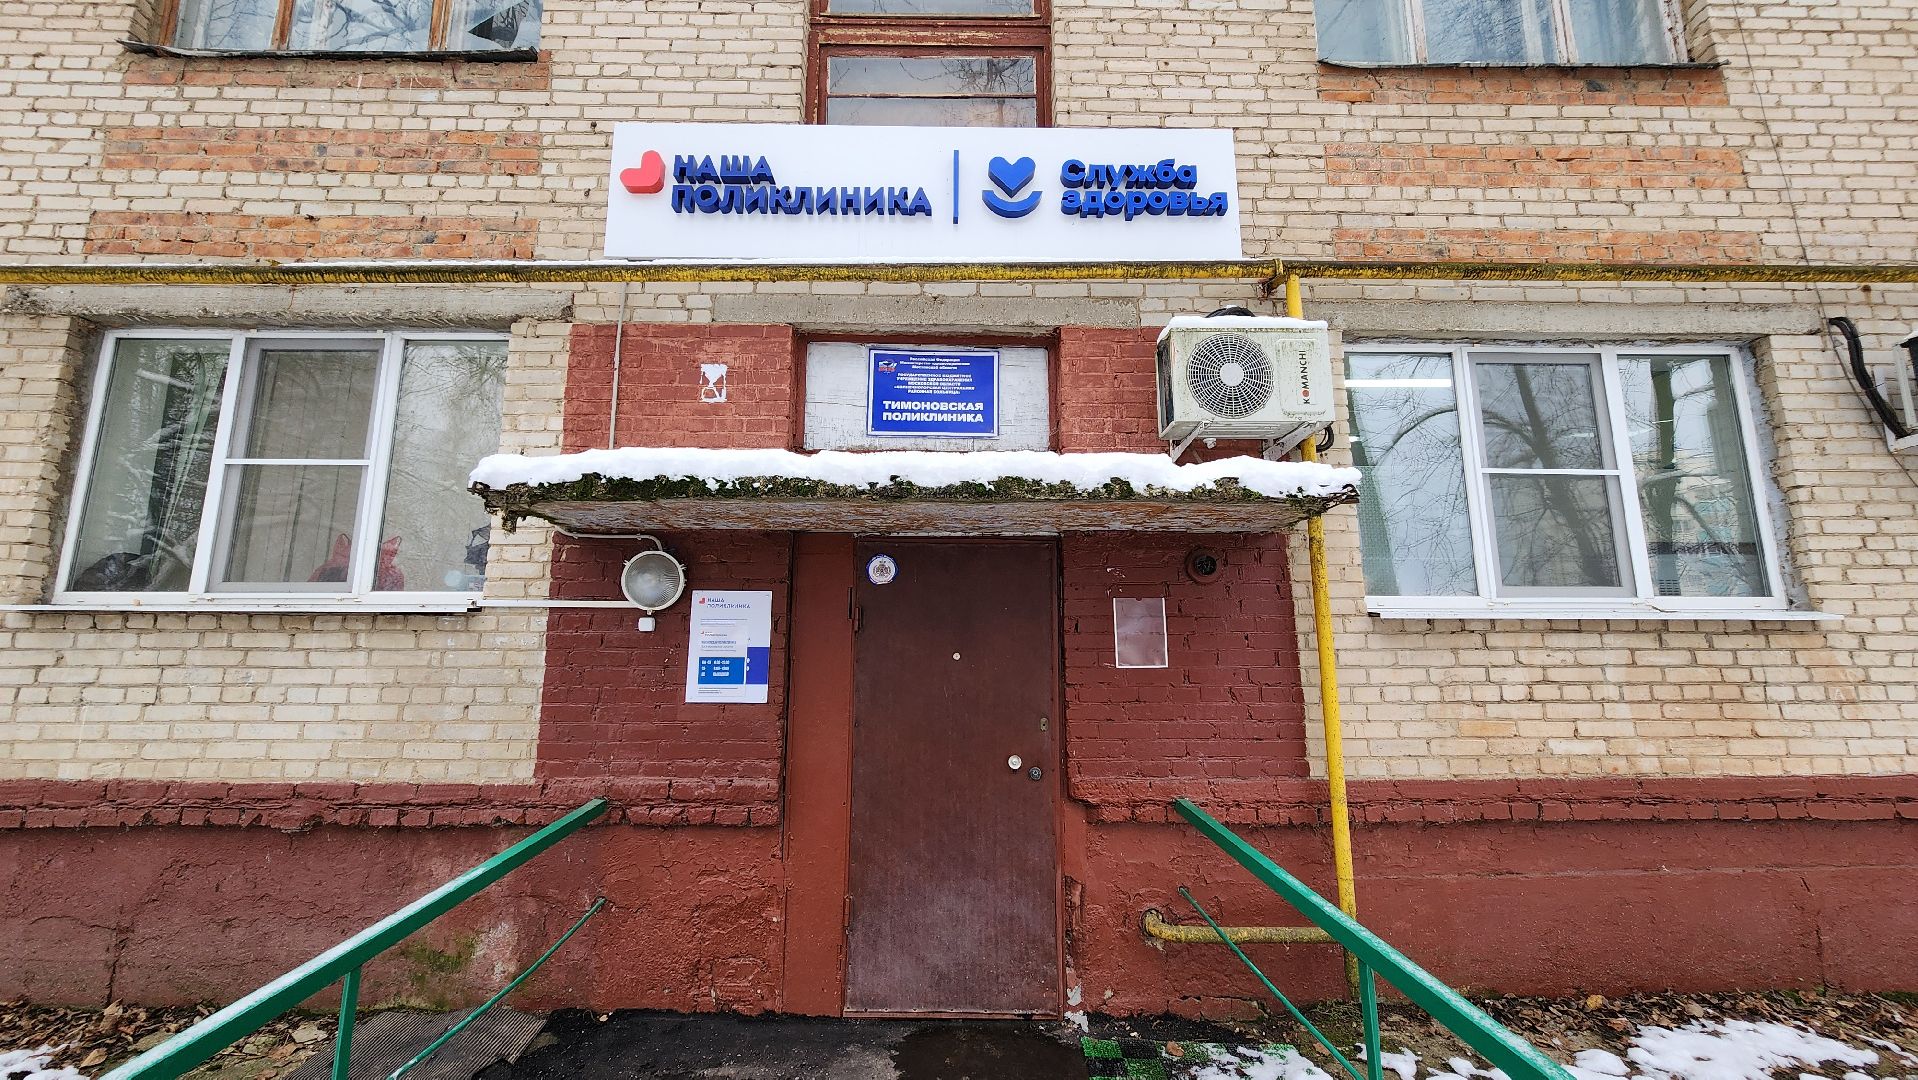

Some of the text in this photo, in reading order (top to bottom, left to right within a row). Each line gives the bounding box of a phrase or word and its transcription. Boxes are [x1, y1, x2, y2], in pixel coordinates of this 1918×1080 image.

[673, 154, 776, 185] НАША
[1060, 158, 1198, 191] Служба
[671, 185, 932, 216] ПОЛИКЛИНИКА
[1061, 189, 1228, 221] здоровья
[1298, 350, 1310, 405] KOMANCHI
[882, 400, 984, 411] ТИМОНОВСКАЯ
[882, 412, 984, 423] ПОЛИКЛИНИКА
